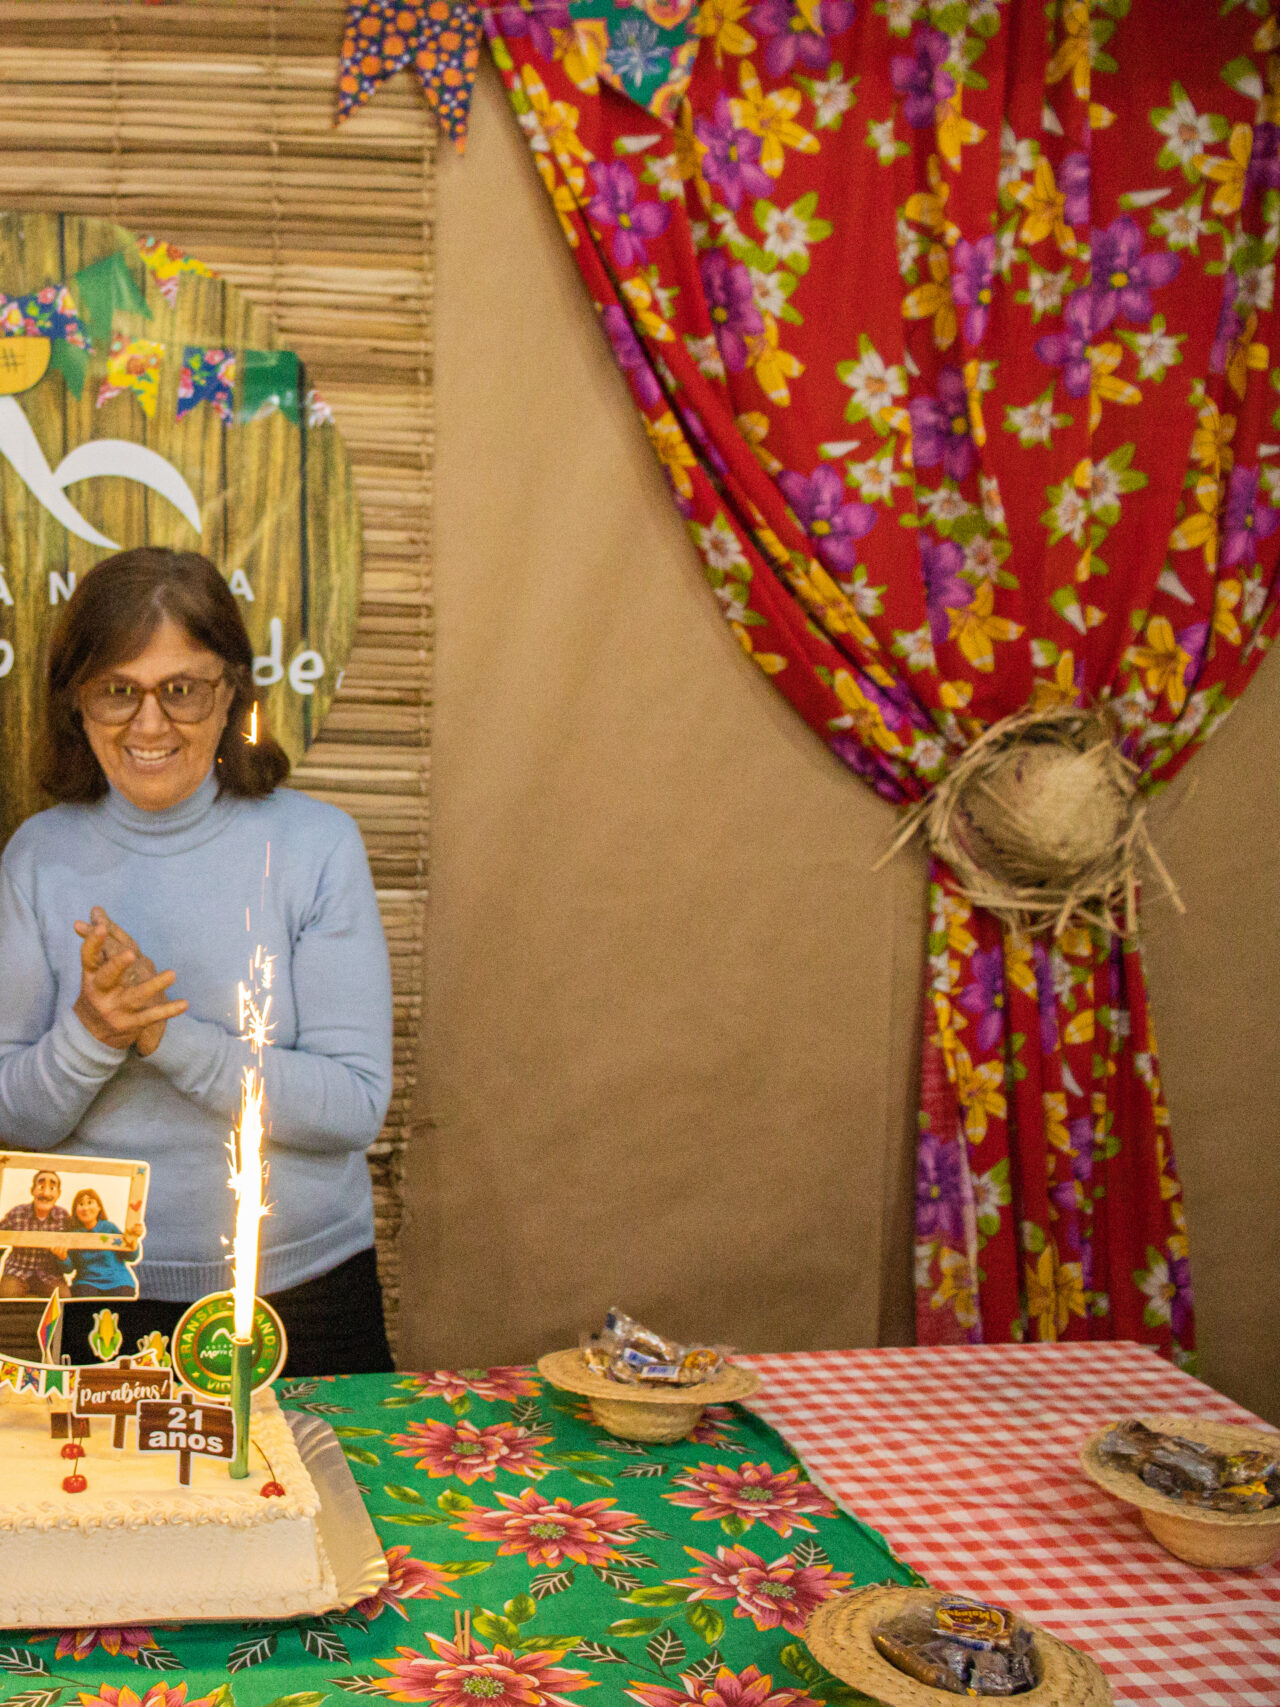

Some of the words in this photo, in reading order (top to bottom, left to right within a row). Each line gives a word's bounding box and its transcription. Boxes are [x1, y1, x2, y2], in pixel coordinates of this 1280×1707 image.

[180, 1300, 277, 1364] TRANSFOANDO
[80, 1379, 168, 1406] Parabéns!
[207, 1380, 231, 1391] VID
[168, 1406, 203, 1431] 21
[148, 1430, 224, 1453] anos
